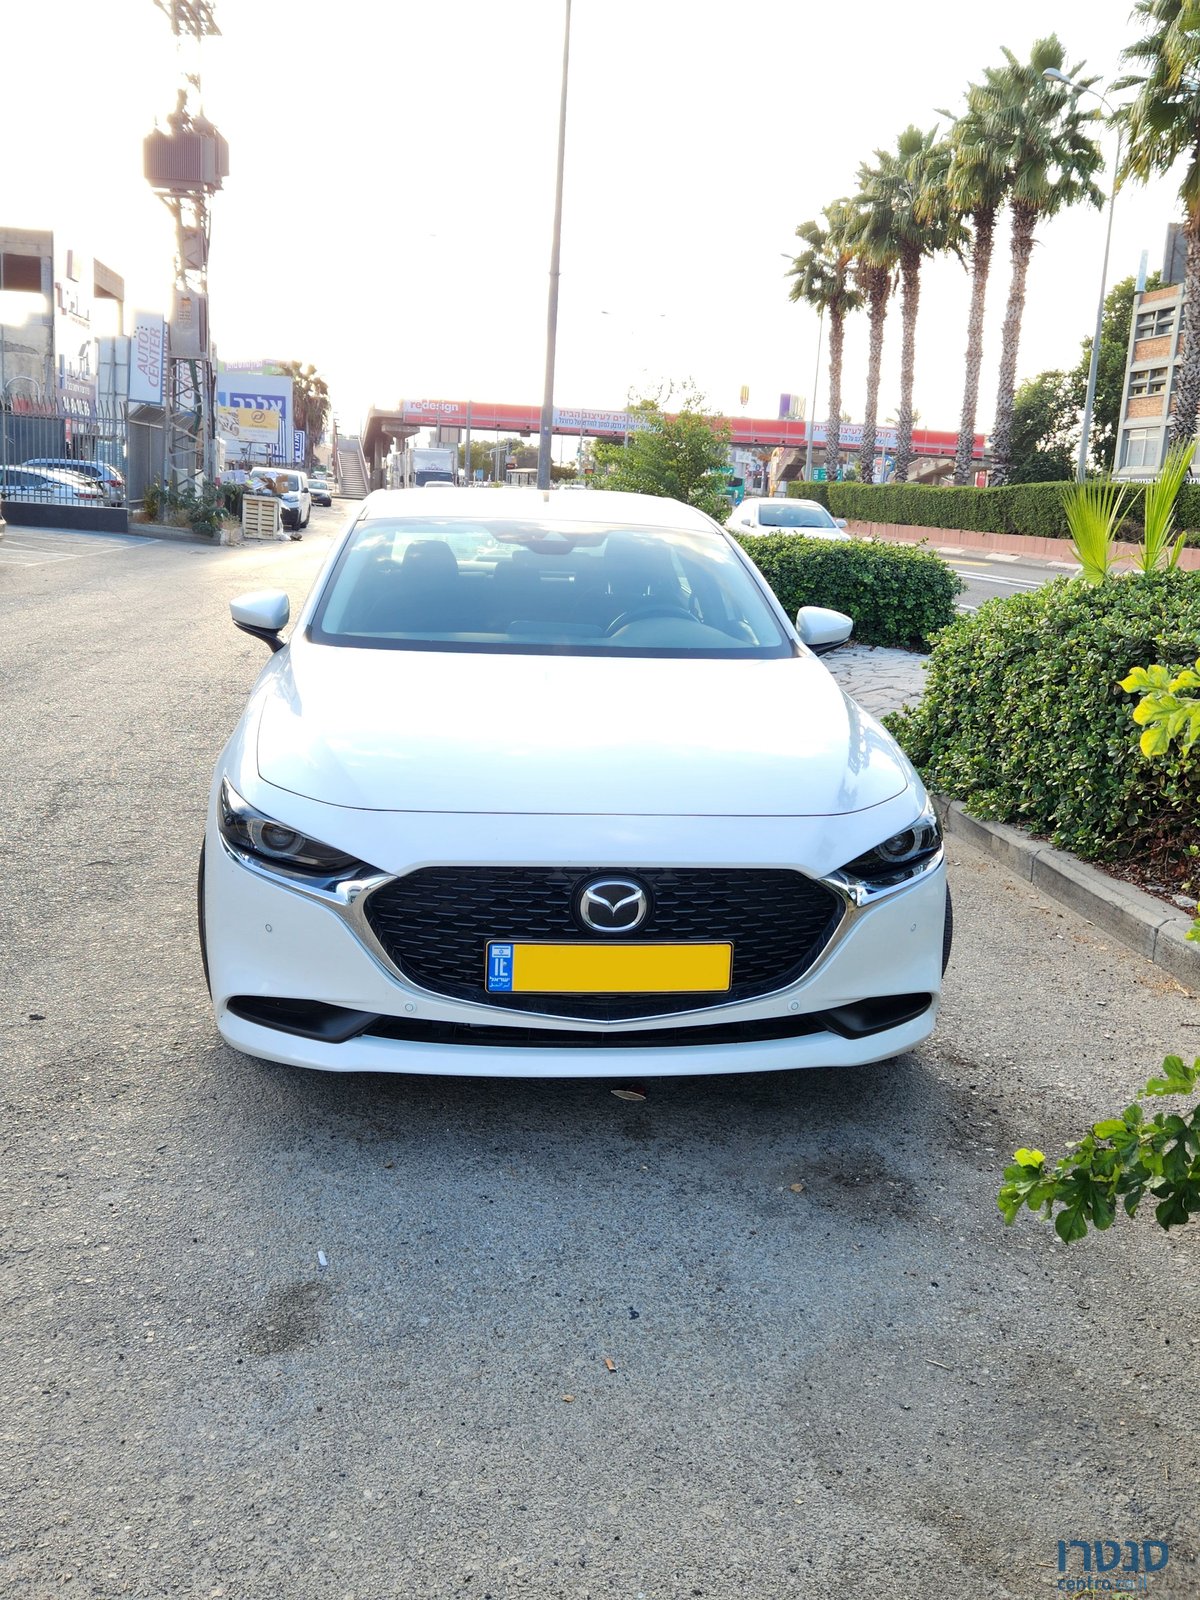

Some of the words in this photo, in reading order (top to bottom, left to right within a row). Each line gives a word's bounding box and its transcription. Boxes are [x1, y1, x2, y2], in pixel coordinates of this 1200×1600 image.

[137, 331, 149, 376] AUTO
[148, 327, 160, 388] CENTER
[410, 400, 459, 414] redesign
[494, 958, 508, 976] IL
